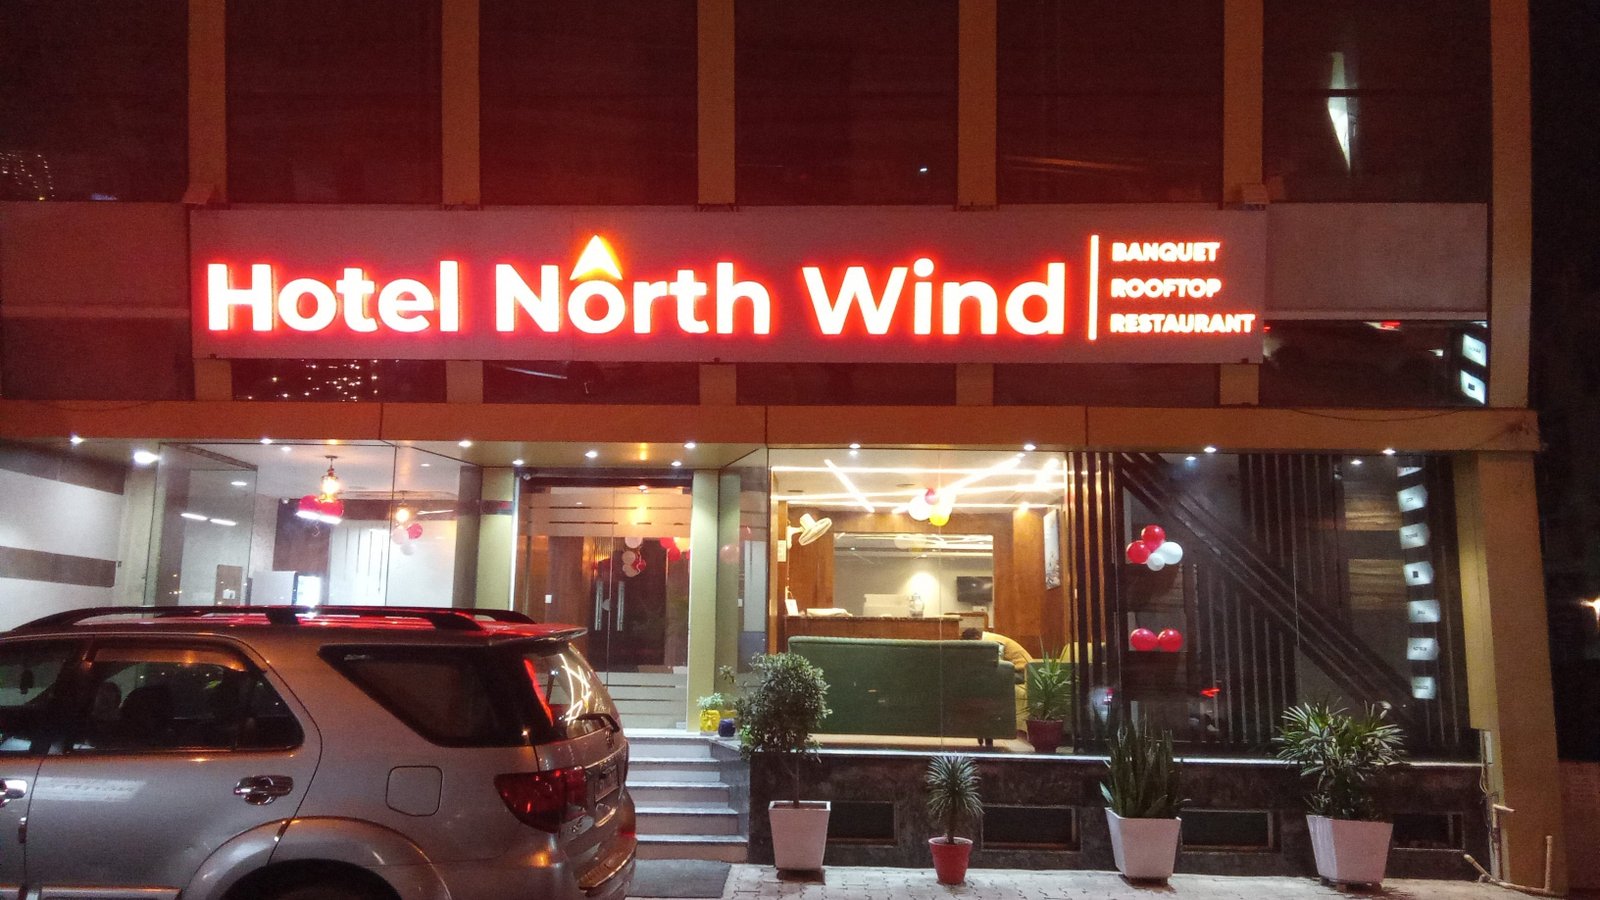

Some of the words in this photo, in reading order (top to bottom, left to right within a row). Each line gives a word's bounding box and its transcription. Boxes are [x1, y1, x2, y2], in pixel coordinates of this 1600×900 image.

[1111, 241, 1221, 263] BANQUET
[207, 260, 459, 333] Hotel
[495, 262, 771, 335] North
[802, 258, 1066, 335] Wind
[1110, 277, 1222, 299] ROOFTOP
[1109, 312, 1256, 334] RESTAURANT
